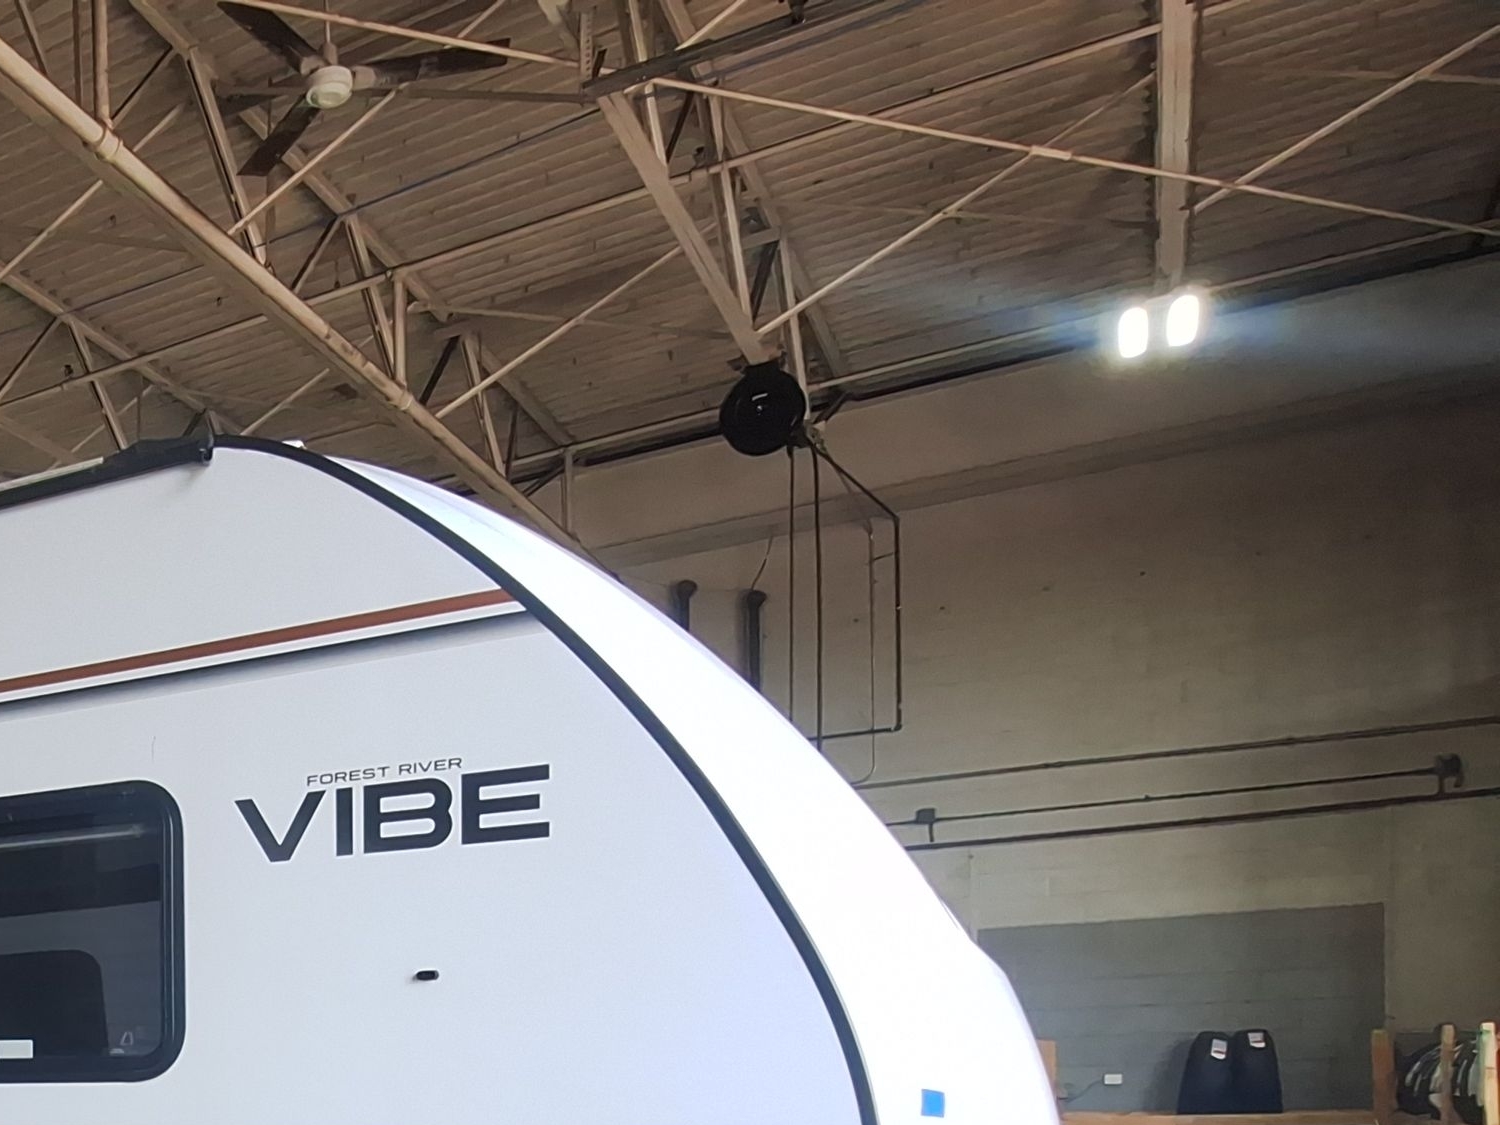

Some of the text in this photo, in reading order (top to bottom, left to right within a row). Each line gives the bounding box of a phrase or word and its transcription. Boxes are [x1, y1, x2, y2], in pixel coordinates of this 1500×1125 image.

[306, 757, 463, 787] FOREST RIVER
[234, 763, 551, 863] VIBE
